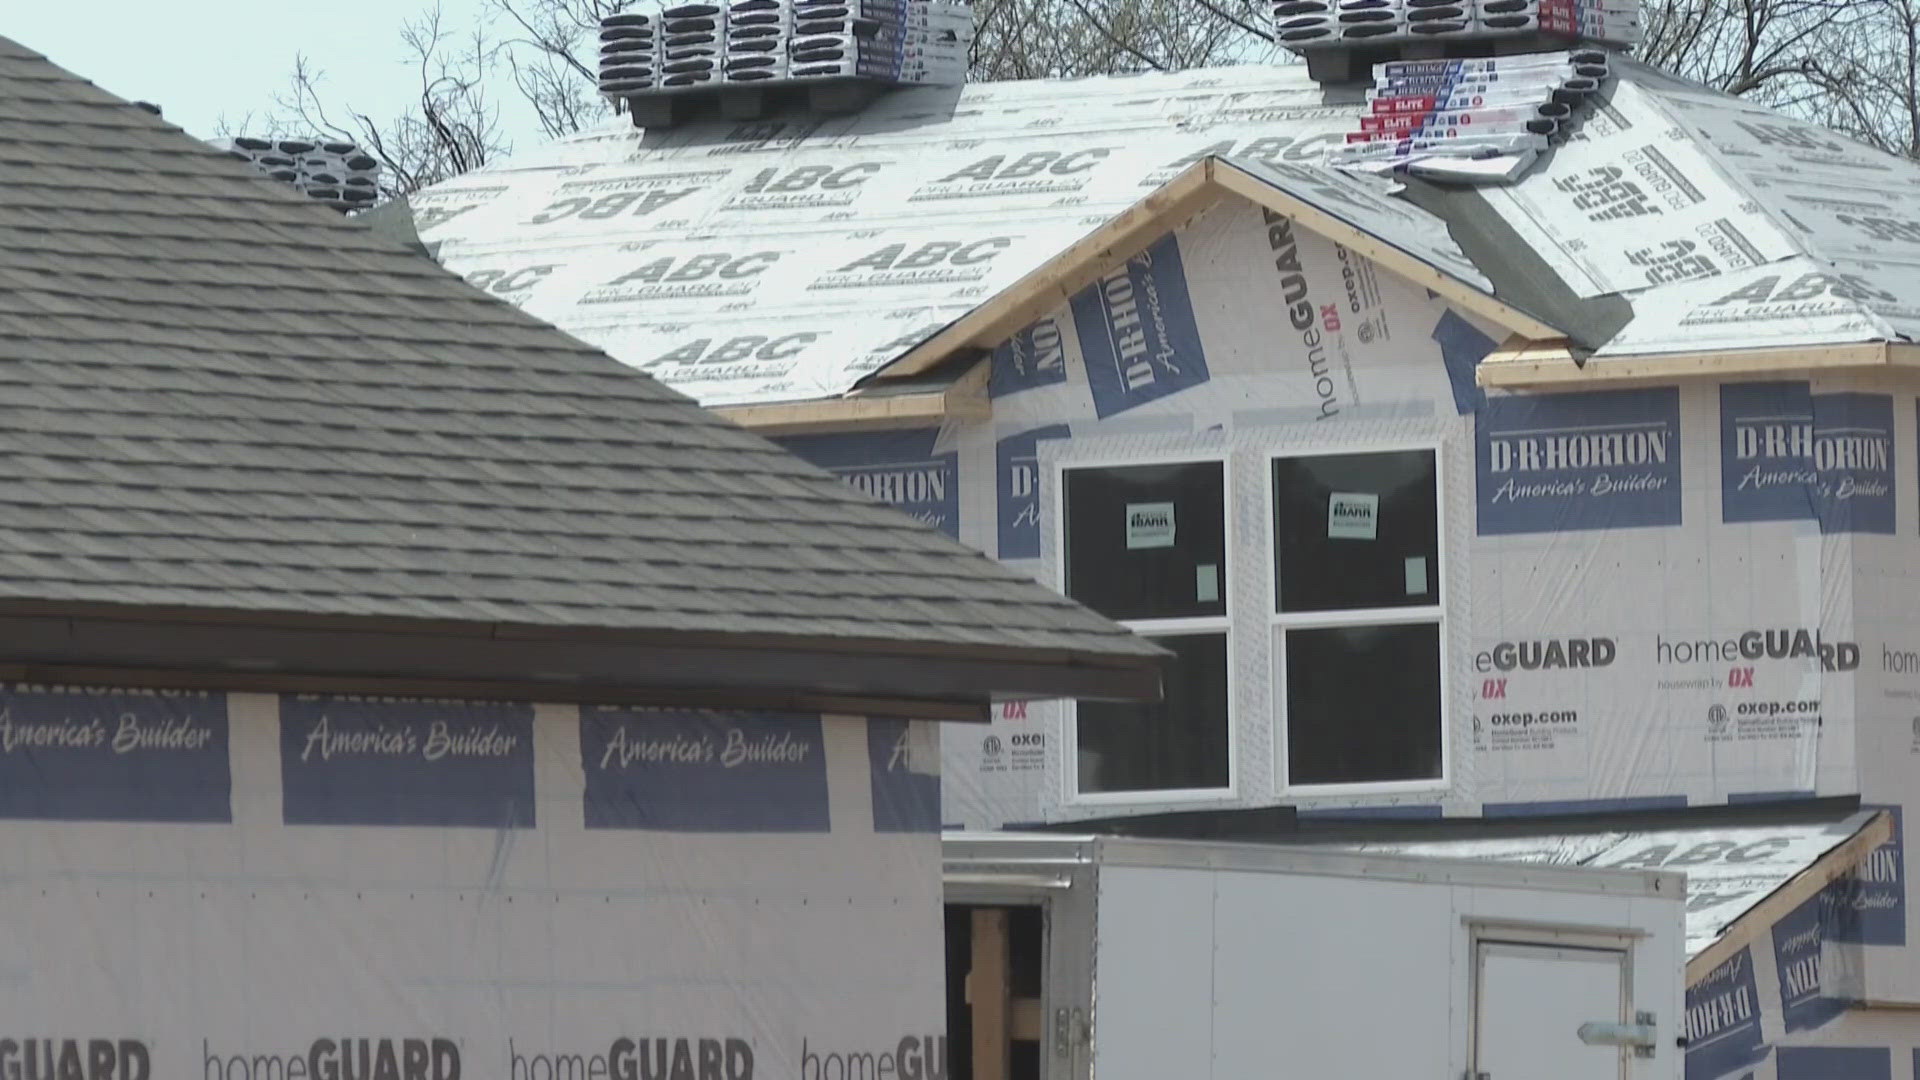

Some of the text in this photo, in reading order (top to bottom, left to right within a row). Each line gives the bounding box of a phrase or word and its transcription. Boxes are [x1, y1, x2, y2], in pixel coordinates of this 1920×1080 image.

[1406, 64, 1443, 74] HERITAGE
[1395, 98, 1424, 109] ELITE
[1384, 116, 1412, 128] ELITE
[927, 146, 1125, 183] ABC
[597, 251, 795, 286] ABC
[828, 236, 1026, 272] ABC
[1319, 303, 1342, 334] OX
[640, 331, 832, 367] ABC
[1492, 473, 1669, 504] America's Builder
[1835, 478, 1890, 500] Builder
[1481, 678, 1508, 701] OX
[1728, 666, 1756, 689] OX
[1003, 699, 1028, 719] OX
[1491, 710, 1577, 728] oxep.com
[112, 713, 212, 754] Builder
[300, 716, 517, 761] America's Builder
[600, 727, 810, 770] America's Builder
[1852, 888, 1899, 911] Builder
[204, 1037, 463, 1080] homeGUARD
[510, 1037, 754, 1080] homeGUARD
